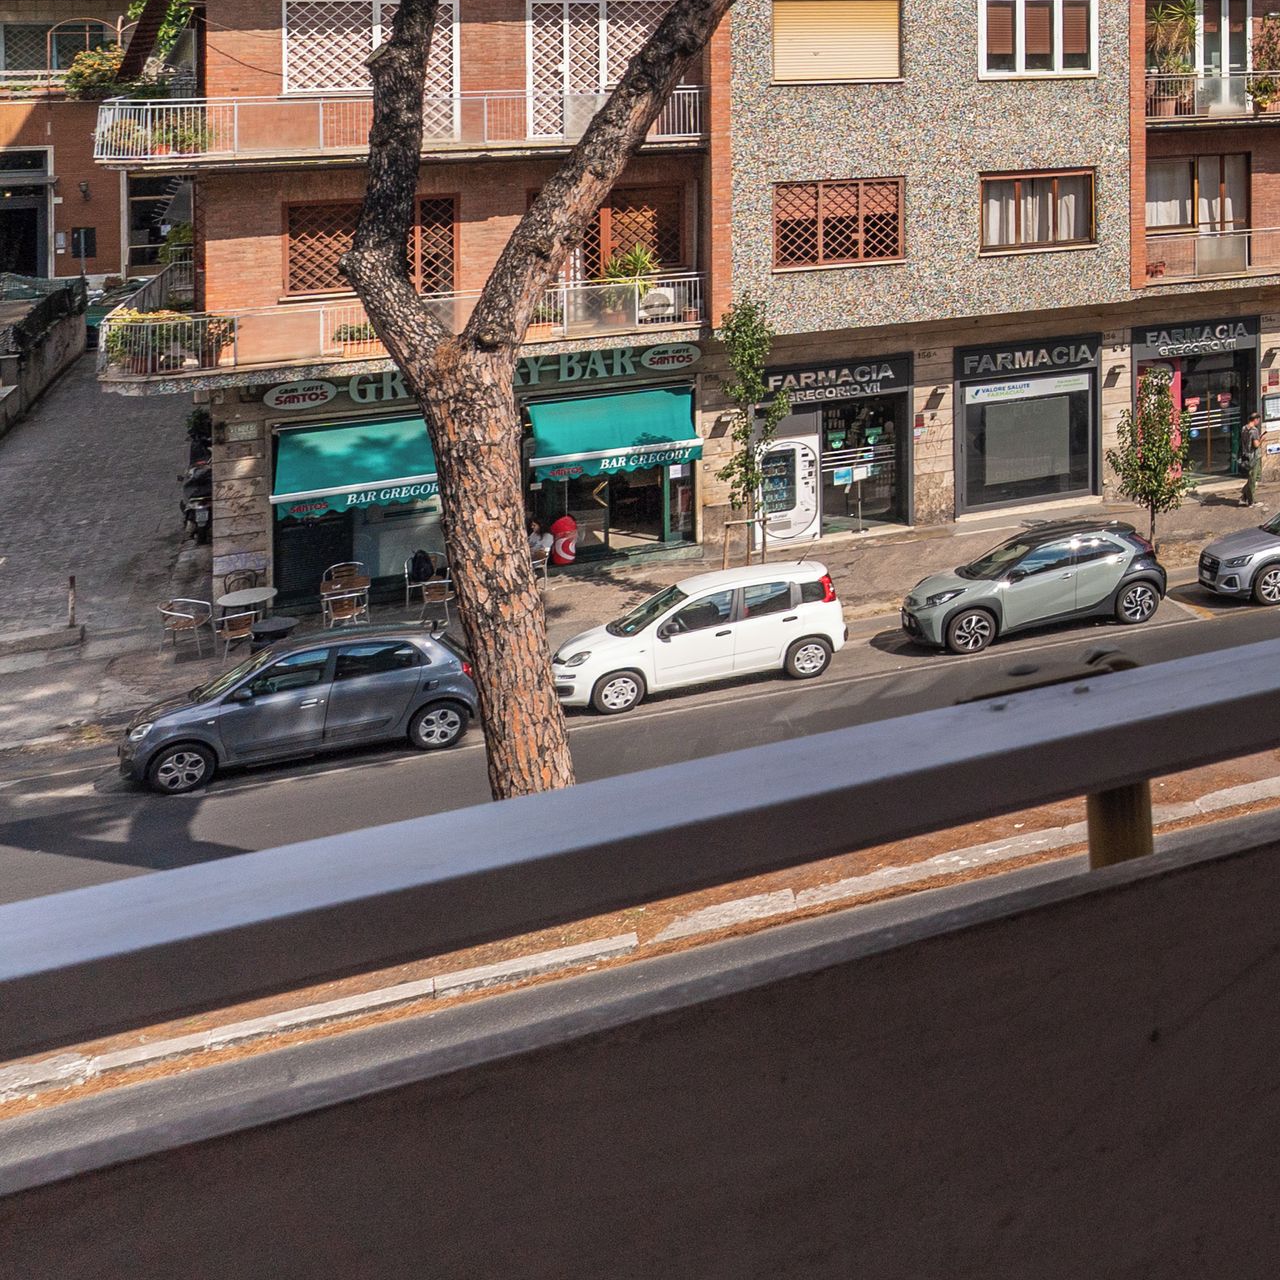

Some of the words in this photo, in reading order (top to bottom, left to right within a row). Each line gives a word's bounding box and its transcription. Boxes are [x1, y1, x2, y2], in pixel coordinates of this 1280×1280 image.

[1145, 323, 1249, 348] FARMACIA
[1158, 339, 1221, 357] GREGORIO
[1222, 338, 1237, 350] VII
[558, 347, 637, 382] BAR
[649, 354, 693, 366] SANTOS
[963, 344, 1096, 375] FARMACIA
[768, 363, 896, 392] FARMACIA
[274, 390, 329, 406] SANTOS
[787, 385, 861, 402] GREGORIO
[861, 382, 881, 394] VII
[982, 386, 1006, 394] VALORE
[1007, 383, 1030, 391] SALUTE
[600, 456, 627, 470] BAR
[629, 448, 692, 466] GREGORY
[549, 466, 583, 476] SANTOS
[346, 491, 376, 505] BAR
[379, 482, 438, 500] GREGOR
[289, 502, 329, 514] SANTOS
